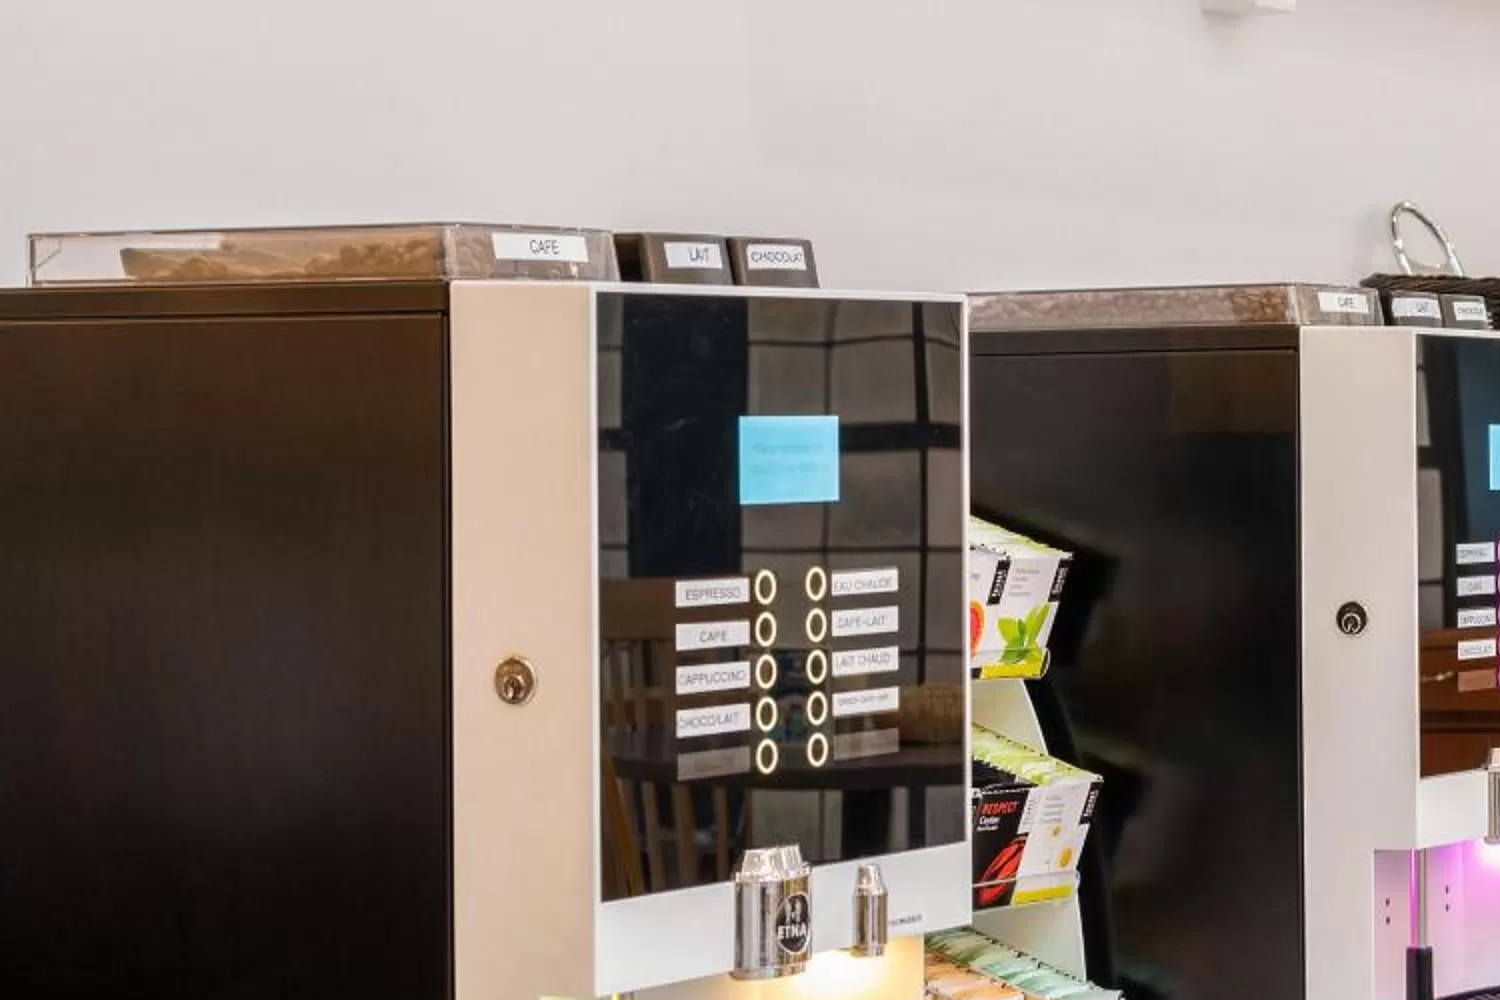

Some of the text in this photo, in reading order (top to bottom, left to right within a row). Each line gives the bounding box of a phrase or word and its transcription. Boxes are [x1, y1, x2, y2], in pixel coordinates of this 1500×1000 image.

[528, 239, 560, 255] CAFE
[685, 583, 741, 601] ESPRESSO
[699, 629, 729, 644] CAFE
[777, 920, 807, 940] ETNA
